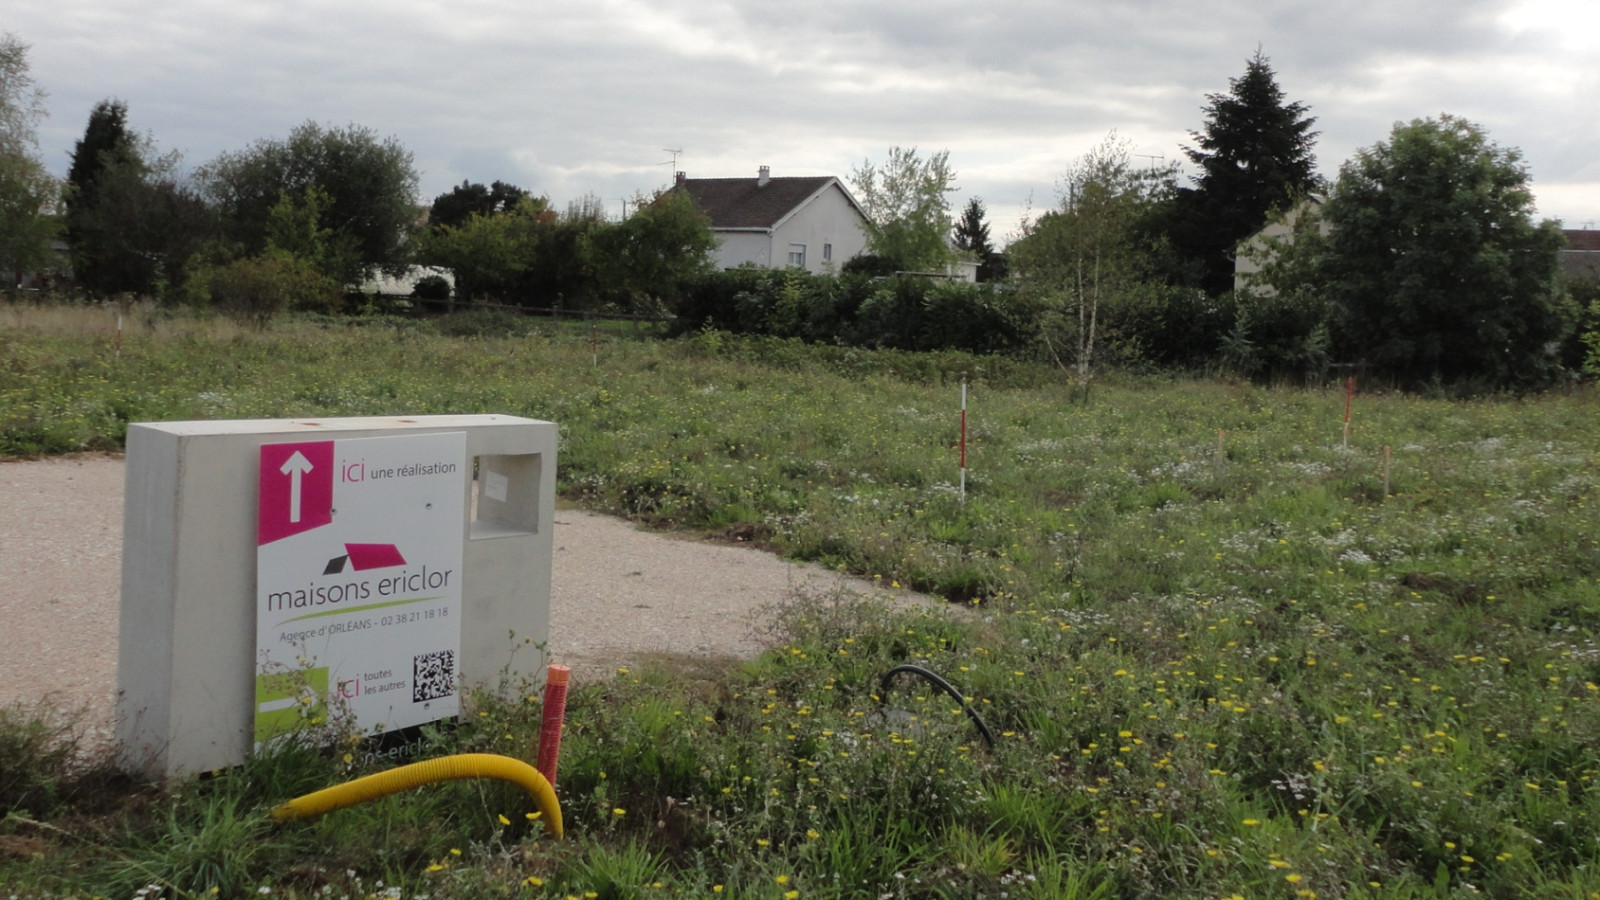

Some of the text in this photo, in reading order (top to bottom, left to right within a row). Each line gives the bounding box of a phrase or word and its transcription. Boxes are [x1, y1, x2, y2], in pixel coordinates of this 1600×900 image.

[341, 458, 456, 483] ici une réalisation
[268, 565, 452, 611] maisons ericlor
[280, 629, 317, 644] Agence
[381, 615, 393, 626] 02
[396, 613, 408, 624] 38
[409, 611, 420, 622] 21
[424, 609, 435, 619] 18
[438, 607, 449, 617] 18
[364, 669, 392, 681] toutes
[364, 680, 406, 695] les autres
